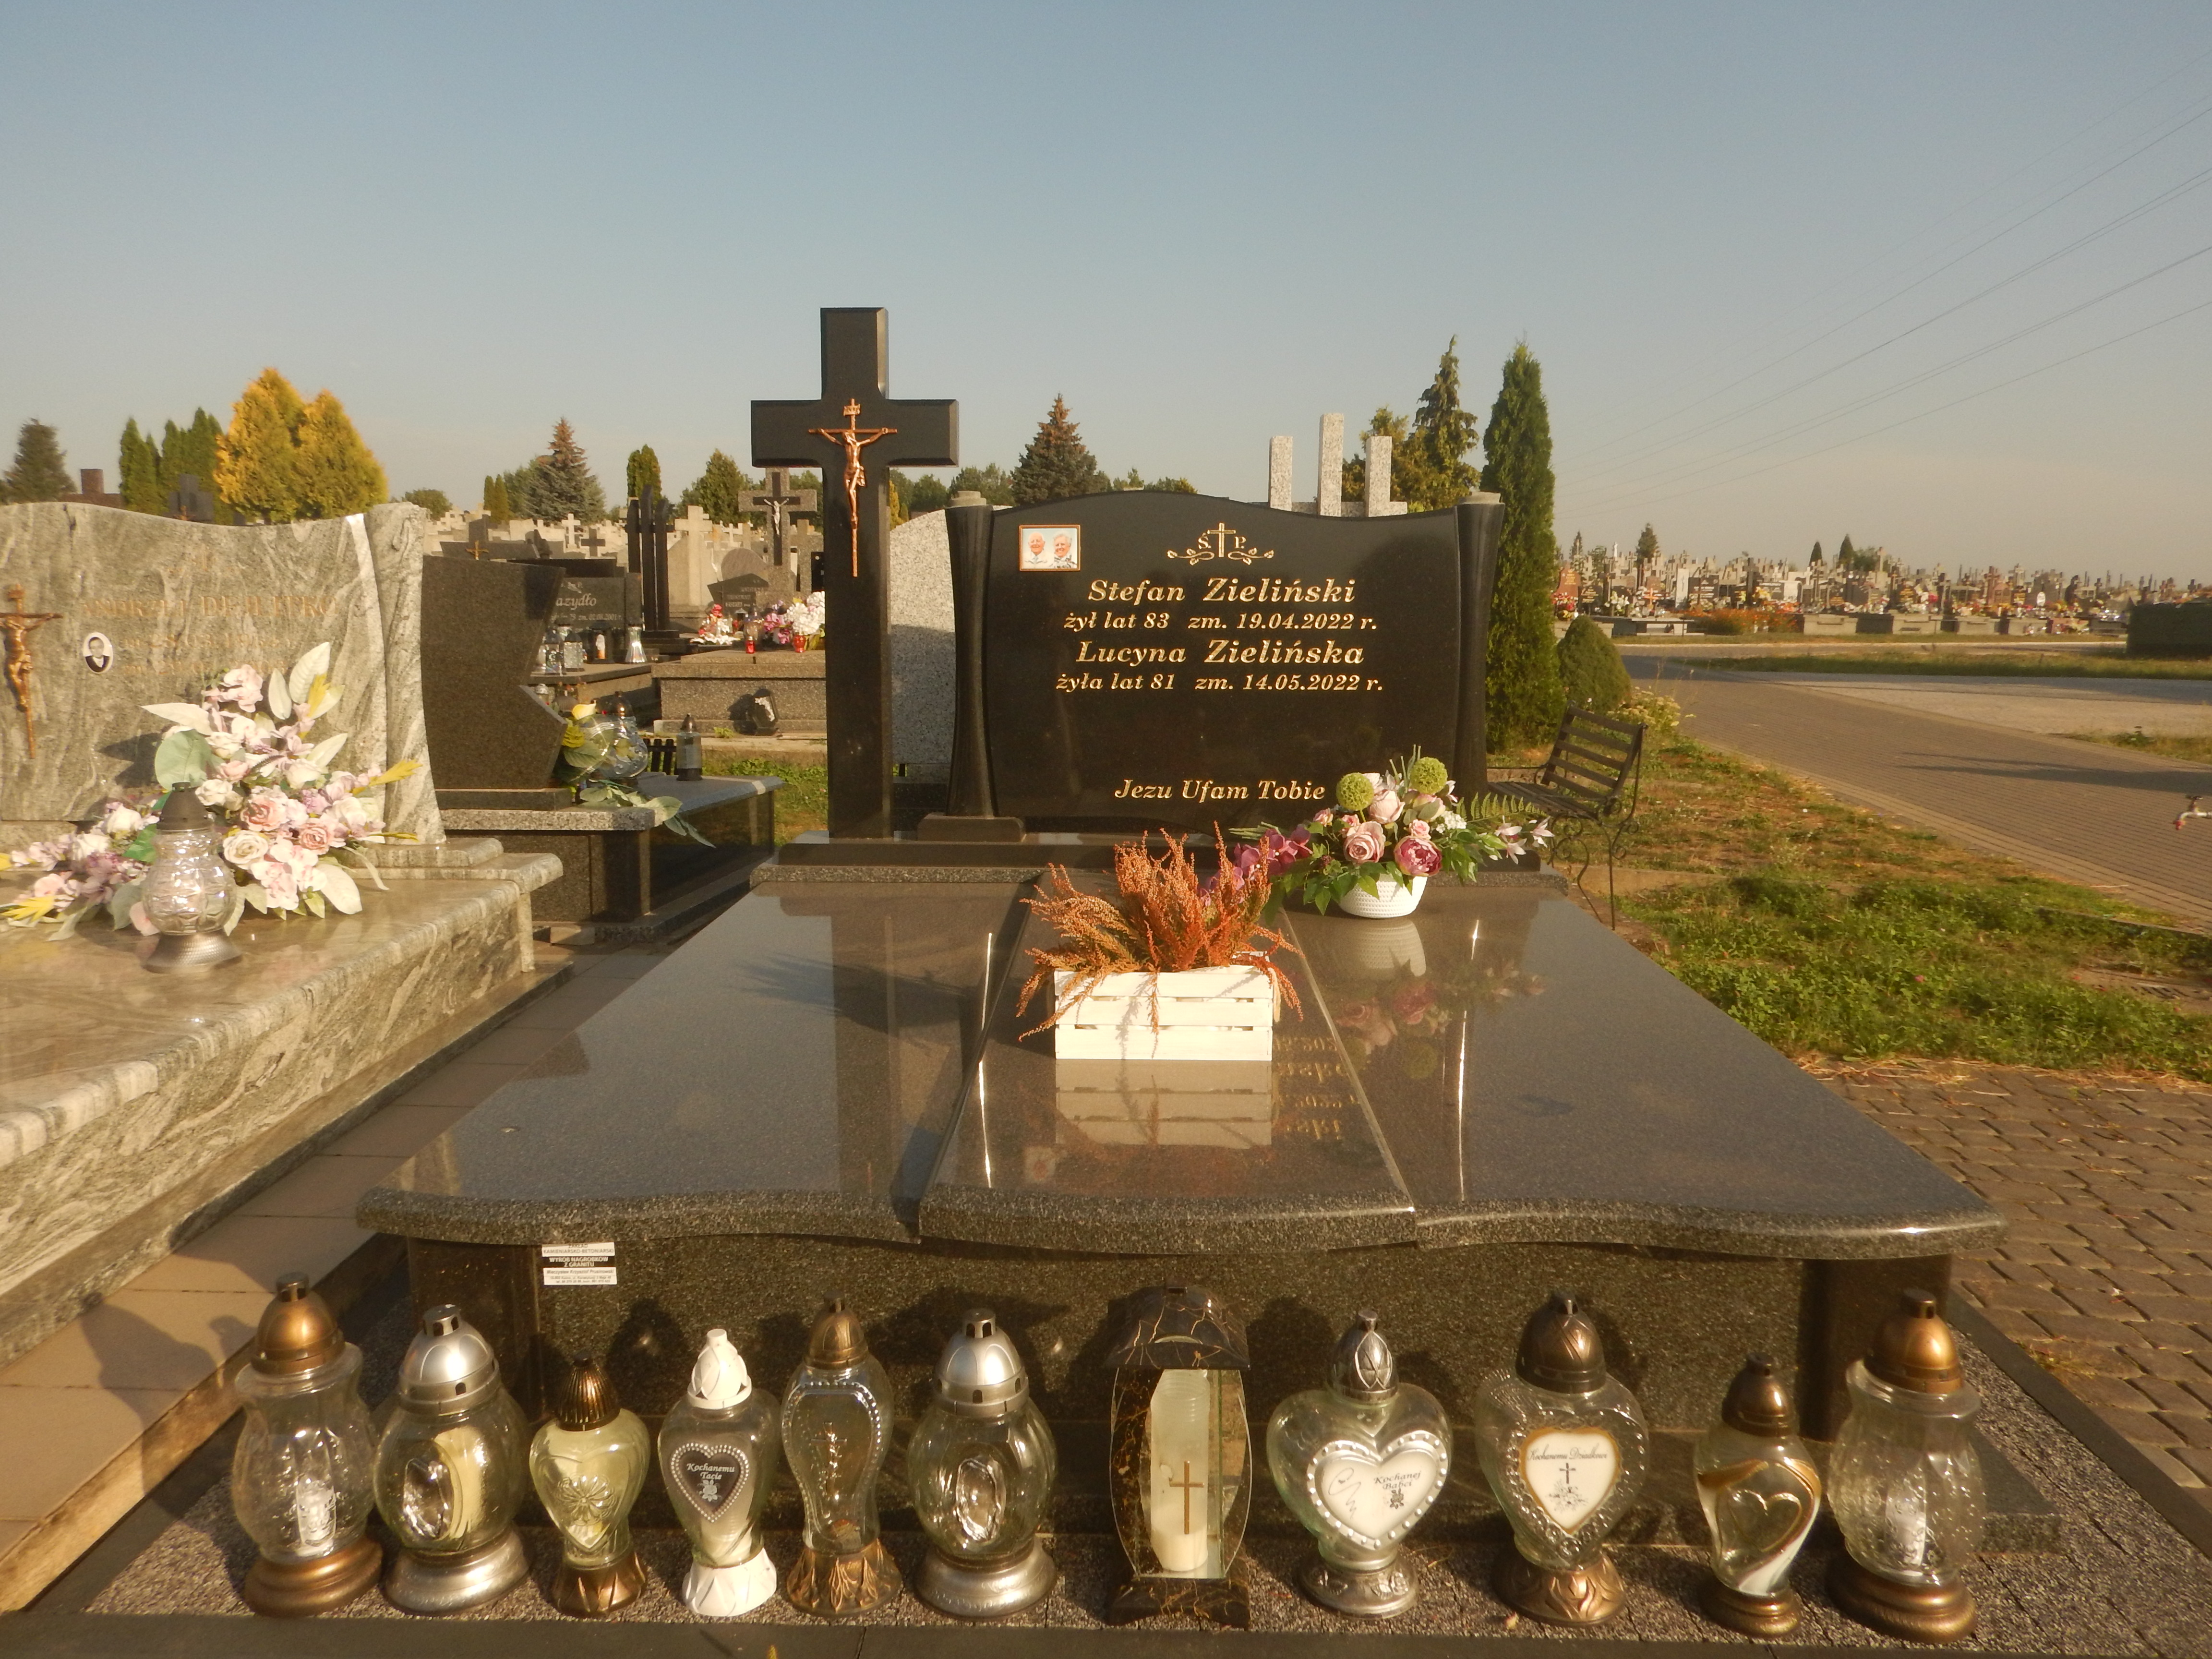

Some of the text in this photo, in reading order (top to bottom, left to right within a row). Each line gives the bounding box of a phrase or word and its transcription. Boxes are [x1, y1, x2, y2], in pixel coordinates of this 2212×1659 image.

[1235, 536, 1246, 549] P.
[1088, 578, 1355, 606] Stefan Zieliński
[555, 593, 597, 610] azydło
[1064, 612, 1377, 632] żył lat 83 zm. 19.04.2022 r.
[1076, 639, 1364, 667] Lucyna Zielińska
[1056, 673, 1383, 693] żyła lat 81 zm. 14.05.2022 r.
[1115, 779, 1325, 803] Jezu Ufam Tobie
[1527, 1443, 1607, 1460] Kochanemu Dziadkowi
[686, 1463, 735, 1472] Kochanemu
[700, 1471, 722, 1480] Tacie
[1373, 1470, 1421, 1484] Kochanej
[1382, 1479, 1413, 1489] Babci
